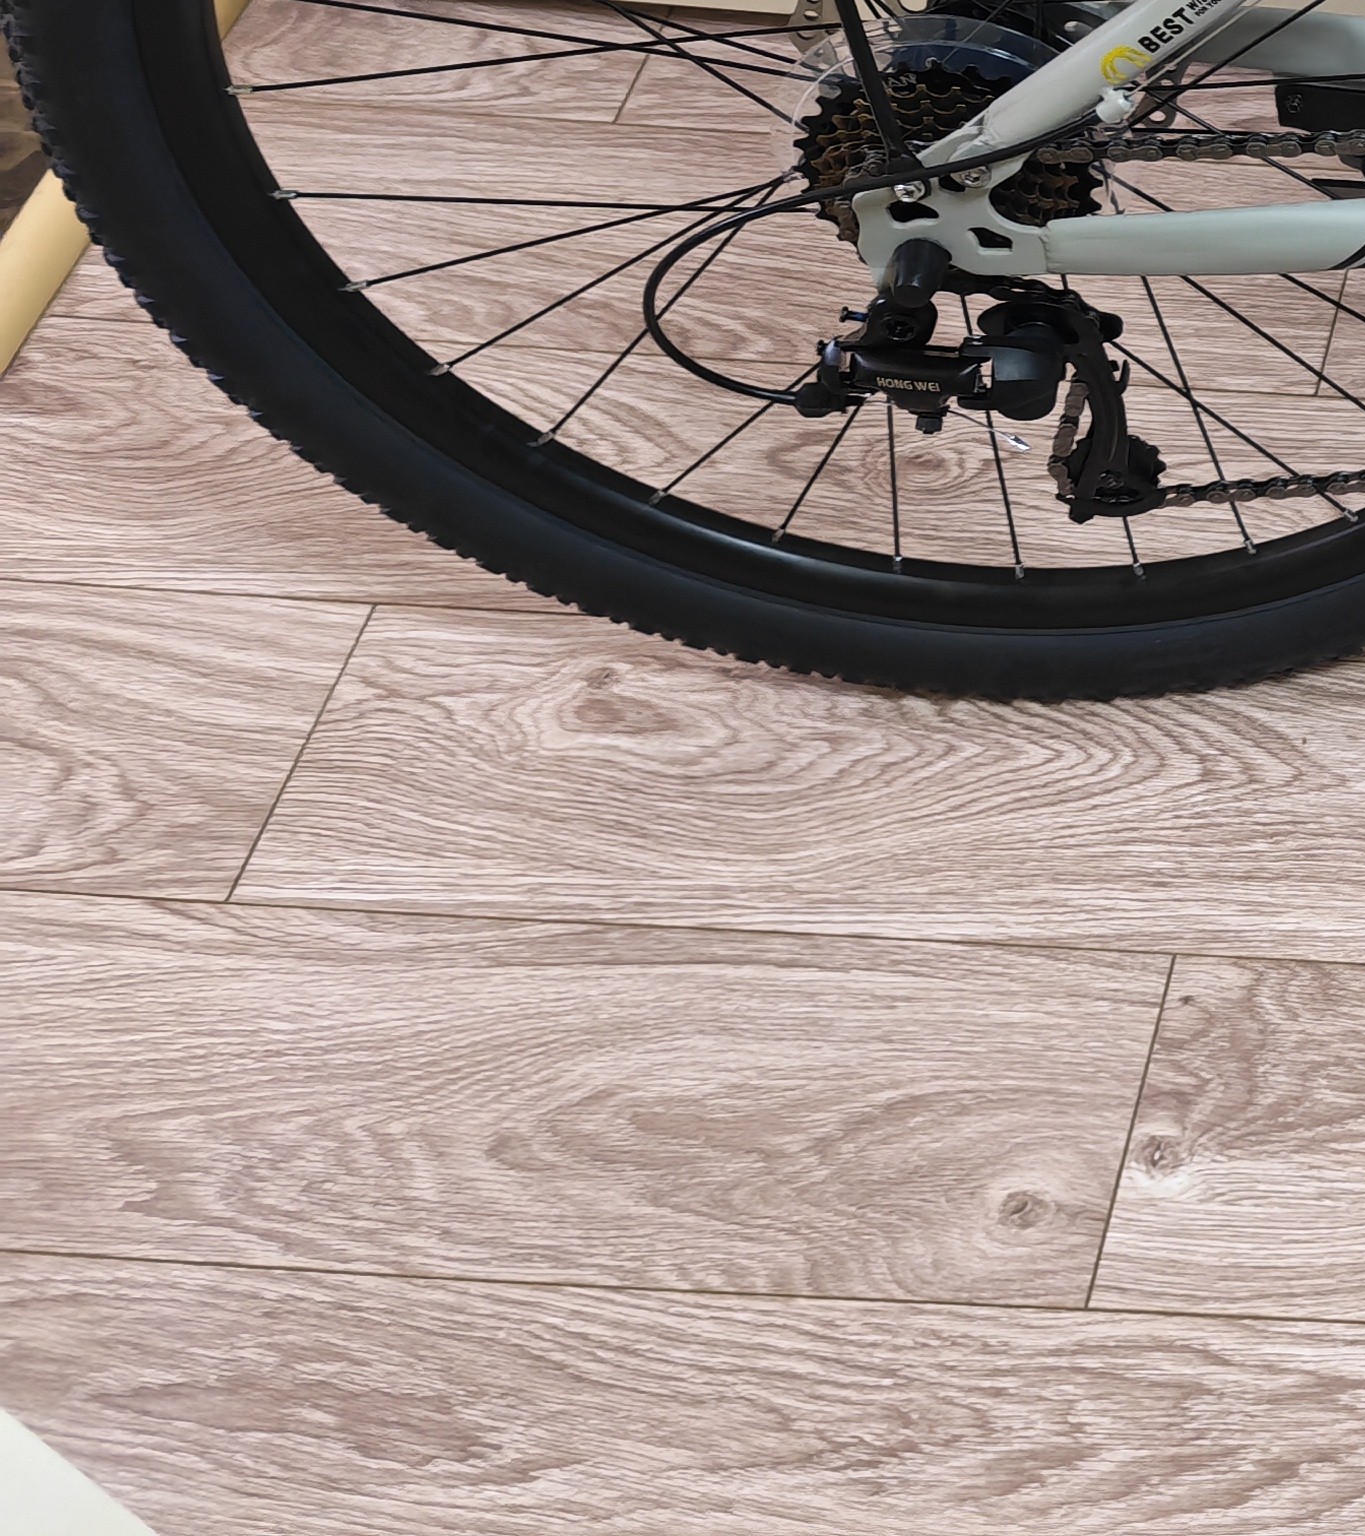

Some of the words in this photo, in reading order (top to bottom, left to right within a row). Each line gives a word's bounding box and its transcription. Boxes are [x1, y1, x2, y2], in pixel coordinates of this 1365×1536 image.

[1194, 6, 1209, 17] FOR
[1137, 7, 1194, 53] BEST
[876, 376, 913, 390] HONG
[913, 381, 941, 392] WEI
